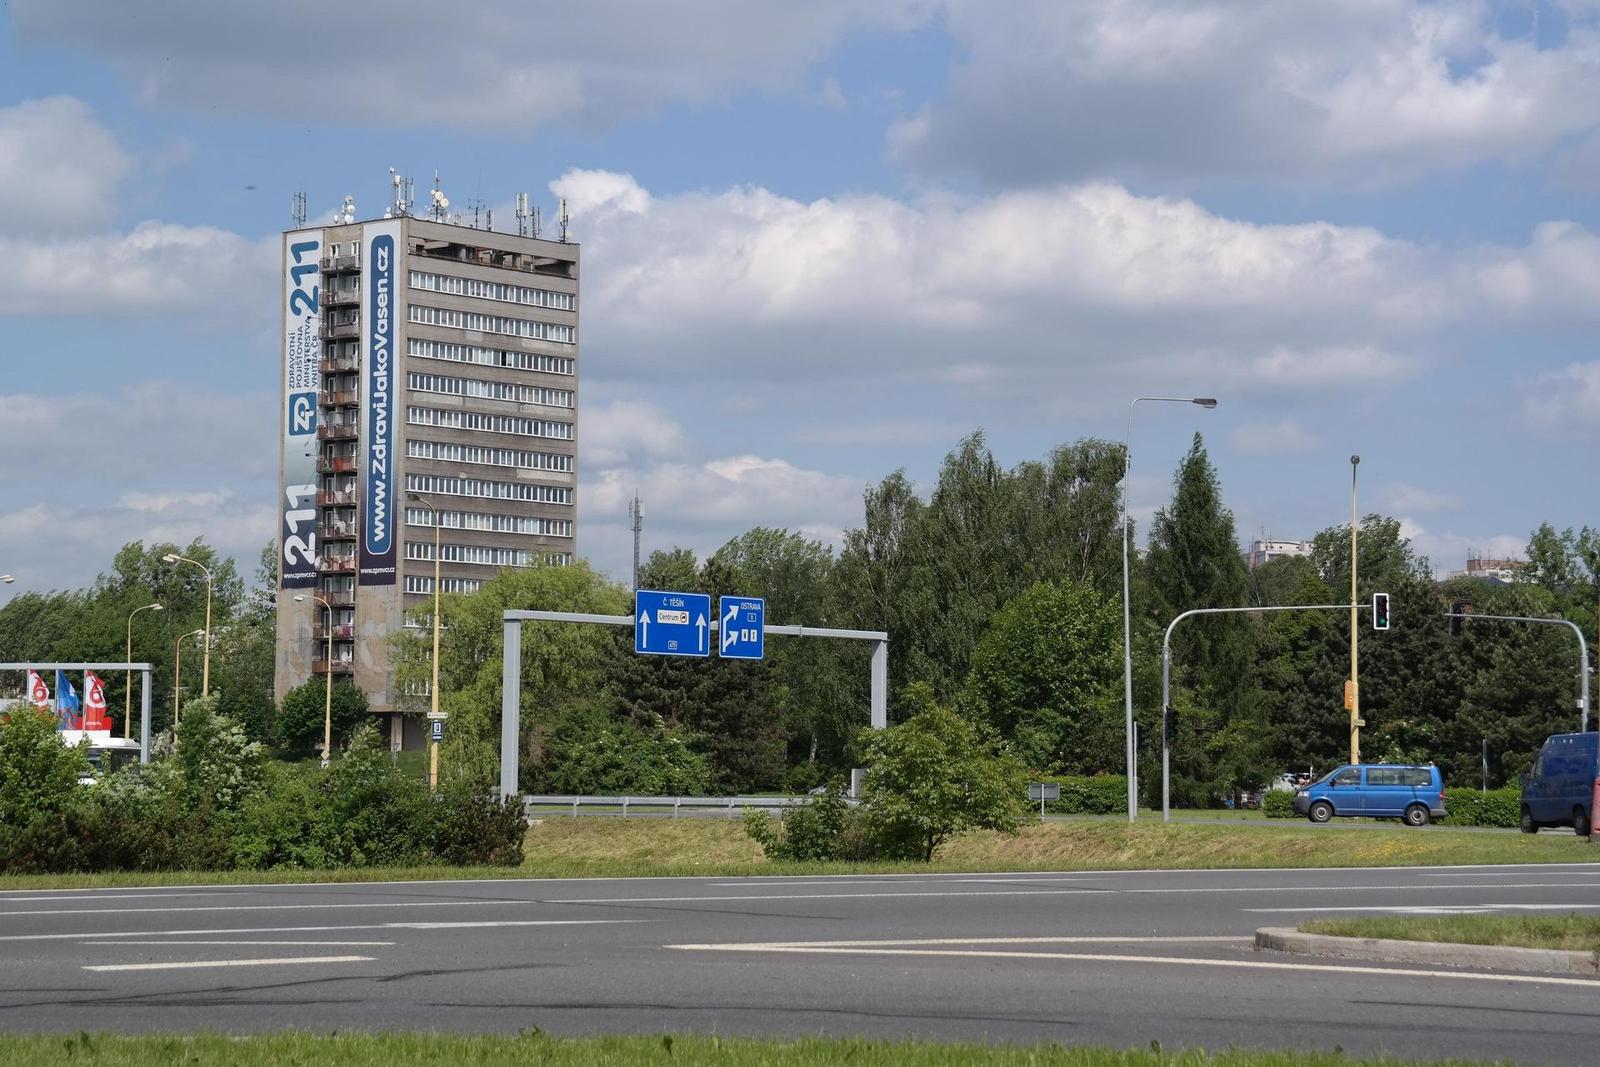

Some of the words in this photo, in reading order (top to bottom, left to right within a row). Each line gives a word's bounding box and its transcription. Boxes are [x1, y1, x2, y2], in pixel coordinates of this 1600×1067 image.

[290, 240, 319, 316] 211
[288, 331, 296, 390] ZDRAVOTNÍ
[303, 318, 312, 388] MINISTERSTVA
[372, 246, 388, 541] www.ZdraviJakoVasen.cz
[284, 484, 317, 566] 211
[659, 612, 679, 621] Centrum
